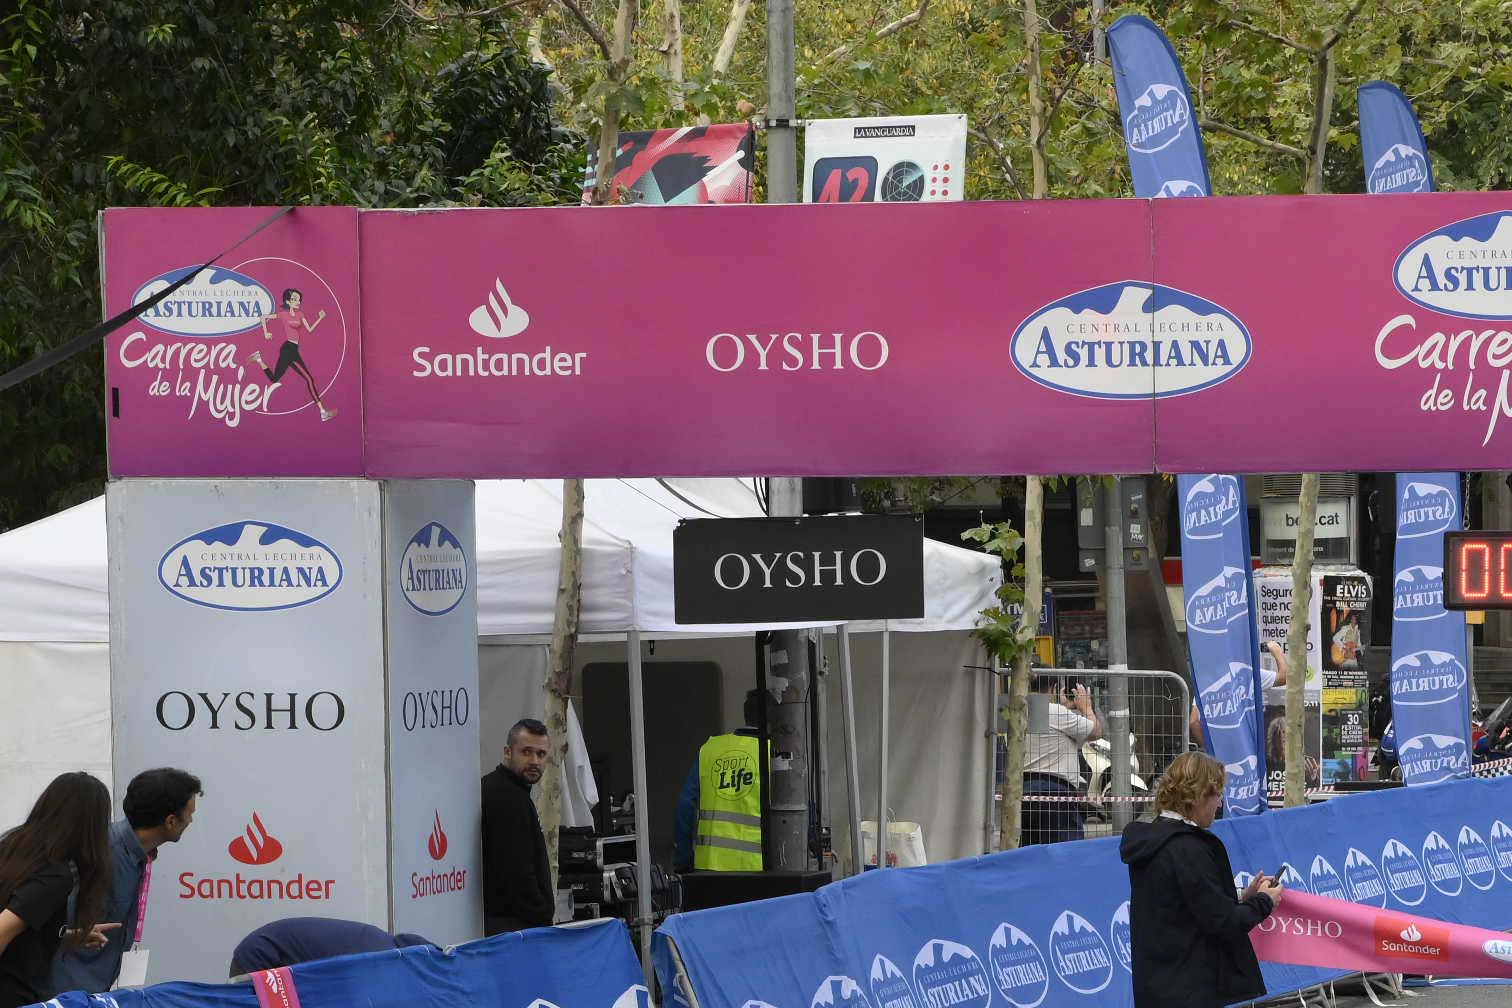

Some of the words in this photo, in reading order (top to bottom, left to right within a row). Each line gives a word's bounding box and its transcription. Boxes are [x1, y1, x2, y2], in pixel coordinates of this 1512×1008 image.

[866, 126, 914, 137] VANGUARDIA
[169, 288, 208, 297] ENTRAL
[1066, 323, 1141, 334] CENTRAL
[1149, 321, 1225, 332] LECHERA
[119, 332, 237, 368] Carrera
[411, 346, 587, 378] Santander
[705, 331, 890, 372] OYSHO
[1029, 325, 1234, 368] ASTURIANA
[149, 371, 171, 396] de
[175, 371, 191, 396] la
[188, 366, 282, 427] Mujer
[1420, 372, 1455, 411] de
[1462, 371, 1487, 411] la
[173, 554, 330, 588] ASTURIANA
[200, 552, 259, 561] CENTRAL
[265, 552, 323, 561] LECHERA
[714, 549, 888, 590] OYSHO
[405, 557, 464, 592] ASTURIANA
[1336, 584, 1367, 597] ELVIS
[1262, 601, 1278, 614] que
[156, 691, 346, 731] OYSHO
[403, 687, 470, 732] OYSHO
[1347, 714, 1359, 724] 30
[713, 755, 749, 774] Sport
[719, 769, 754, 790] Life
[178, 872, 336, 900] Santander
[411, 866, 467, 900] Santander
[1056, 944, 1110, 976] ASTURIANA
[1381, 940, 1441, 956] Santander
[995, 957, 1046, 991] ASTURIANA
